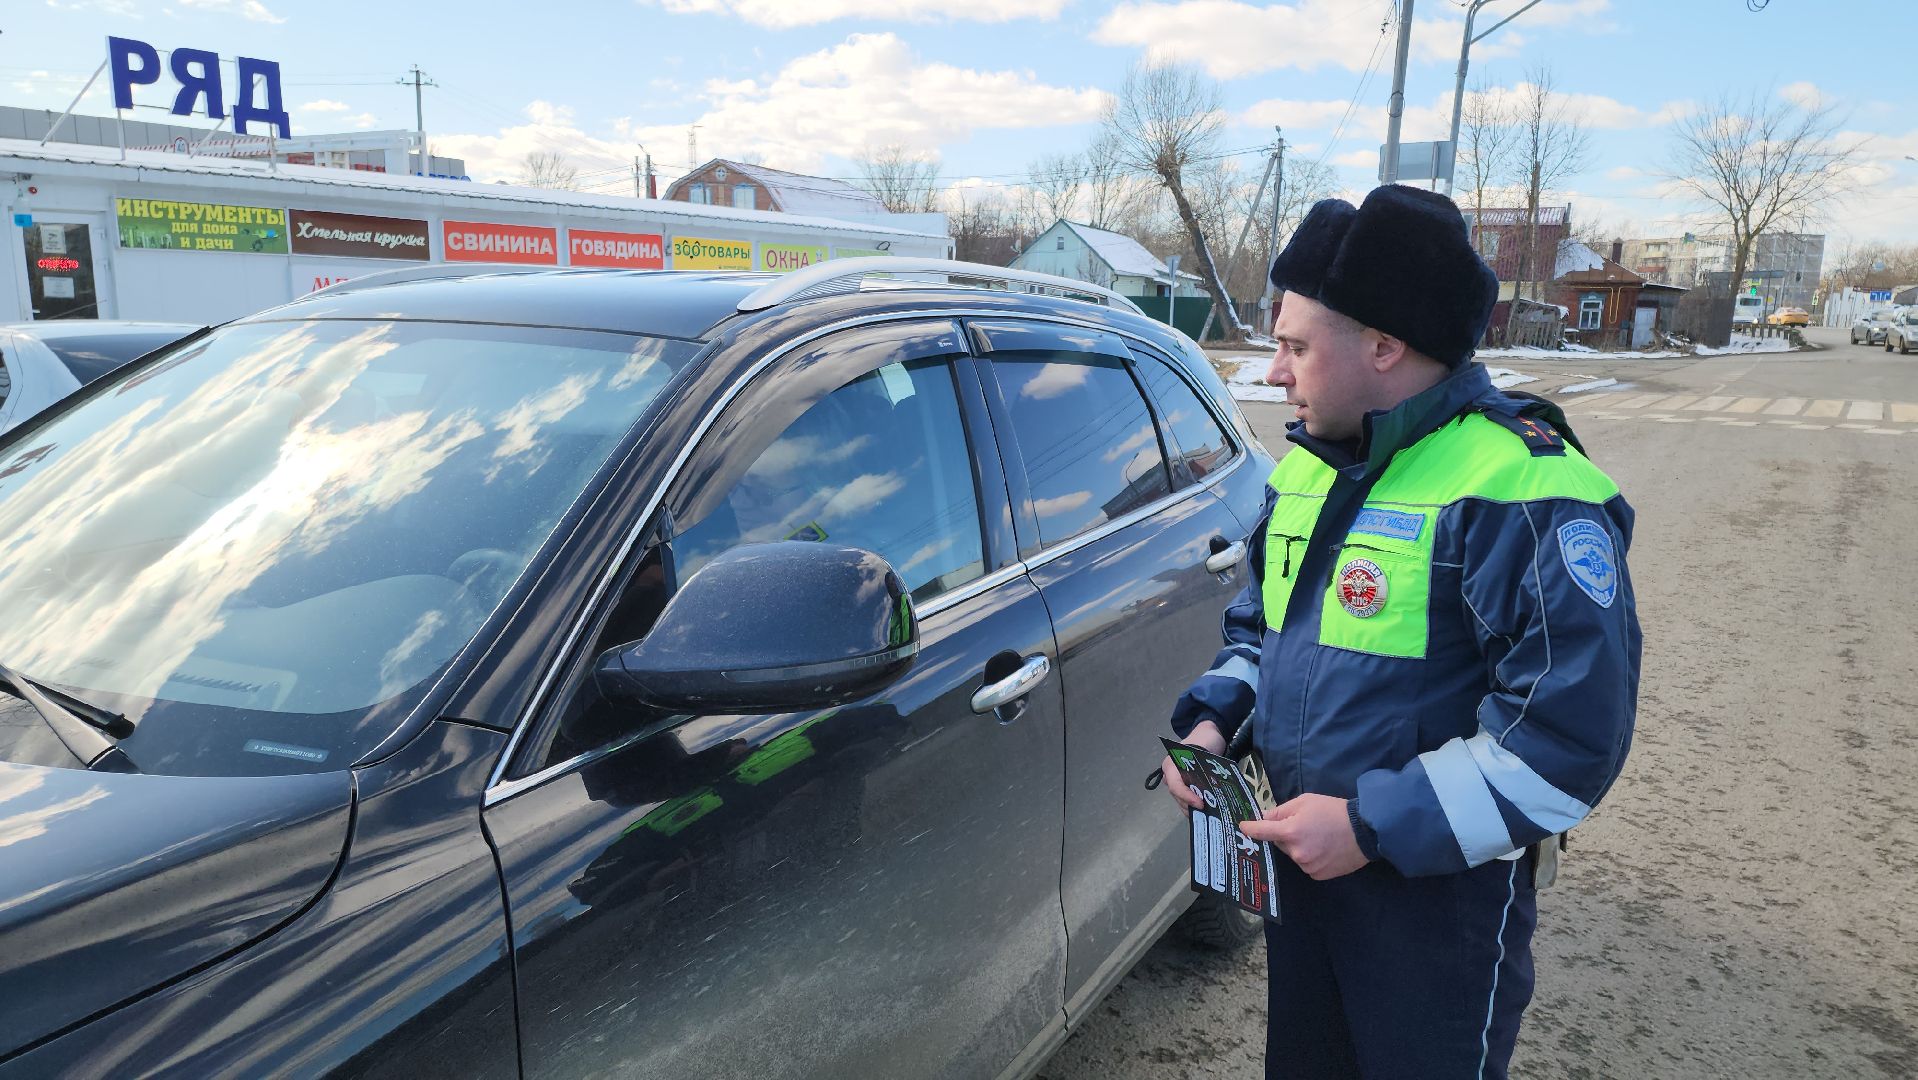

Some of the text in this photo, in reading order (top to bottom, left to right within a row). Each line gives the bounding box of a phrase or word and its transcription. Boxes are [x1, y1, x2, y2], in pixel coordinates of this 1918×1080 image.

[106, 35, 291, 140] РЯД
[116, 198, 286, 226] ИНСТРУМЕНТЫ
[171, 222, 238, 235] для дома
[296, 222, 371, 243] Хмельная
[180, 237, 234, 250] и дачи
[447, 232, 555, 255] СВИНИНА
[571, 238, 662, 260] ГОВЯДИНА
[674, 241, 751, 259] ЗООТОВАРЫ
[766, 249, 810, 269] ОКНА
